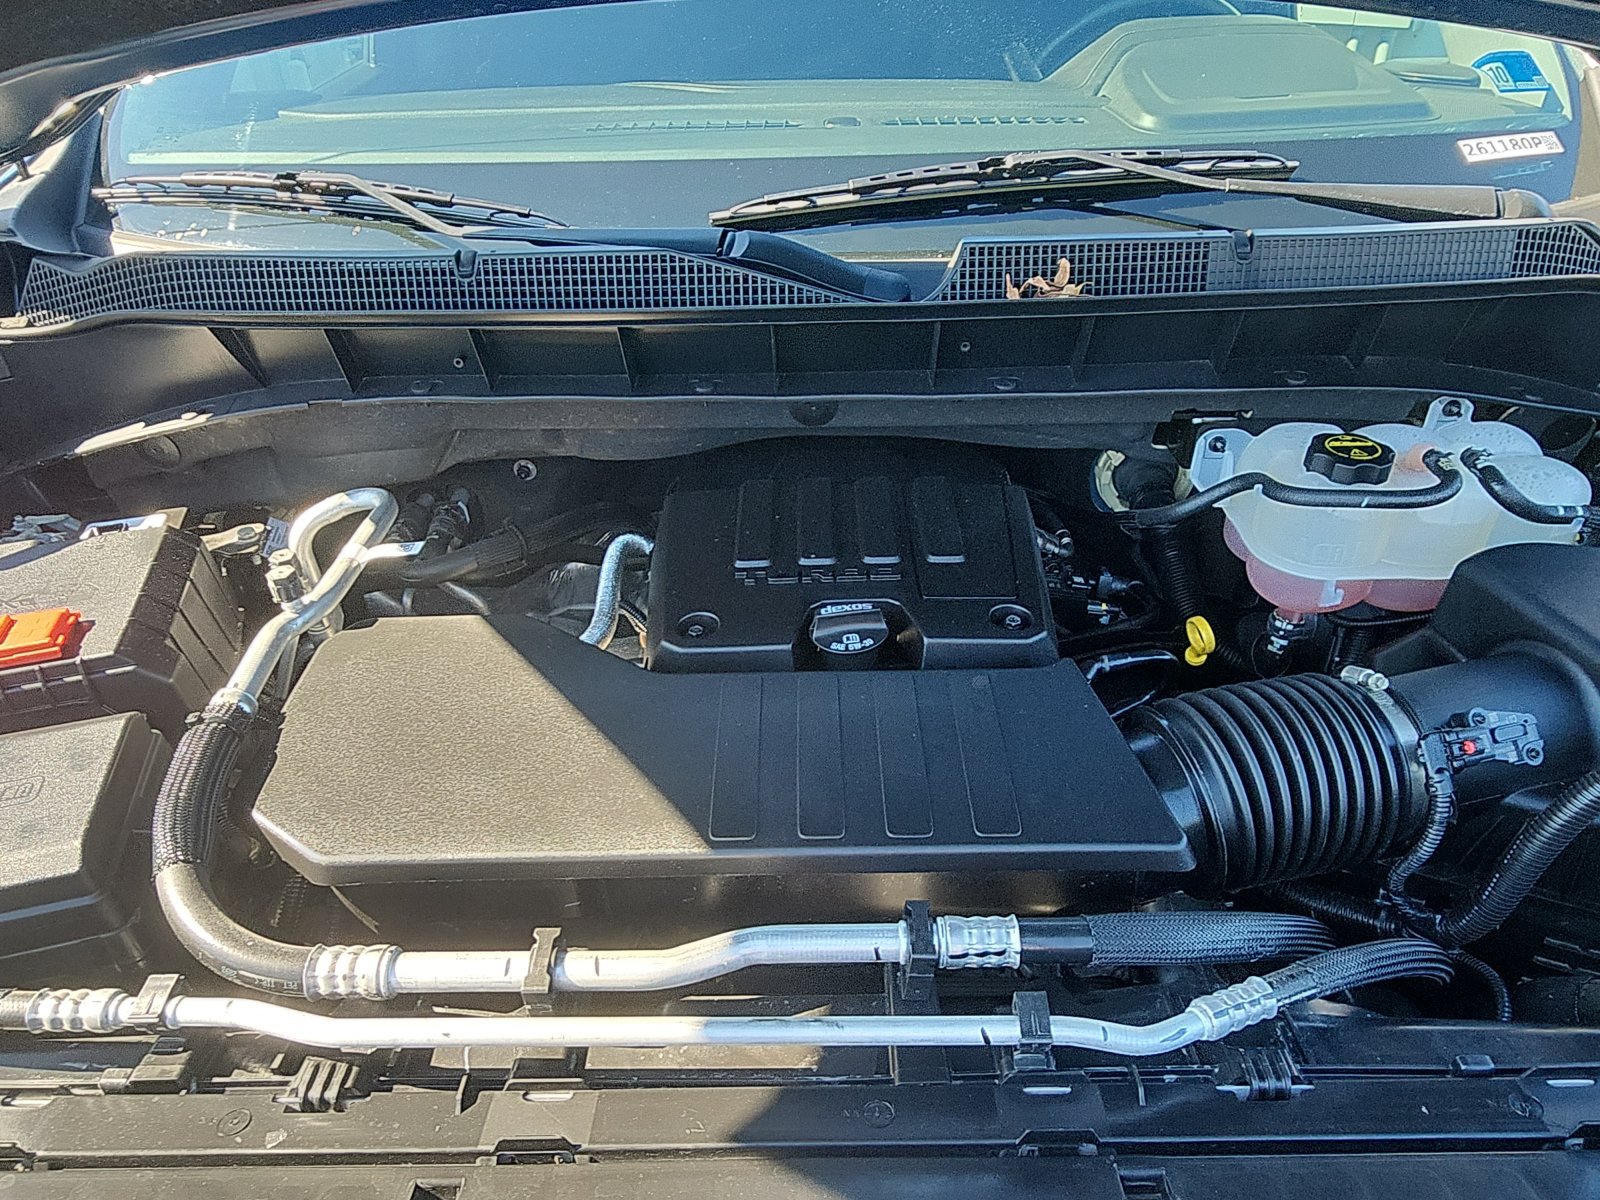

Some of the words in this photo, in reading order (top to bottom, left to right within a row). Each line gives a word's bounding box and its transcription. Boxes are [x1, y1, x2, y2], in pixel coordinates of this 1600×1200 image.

[1487, 65, 1510, 84] 10
[820, 602, 873, 615] dexos
[830, 641, 846, 651] SAE
